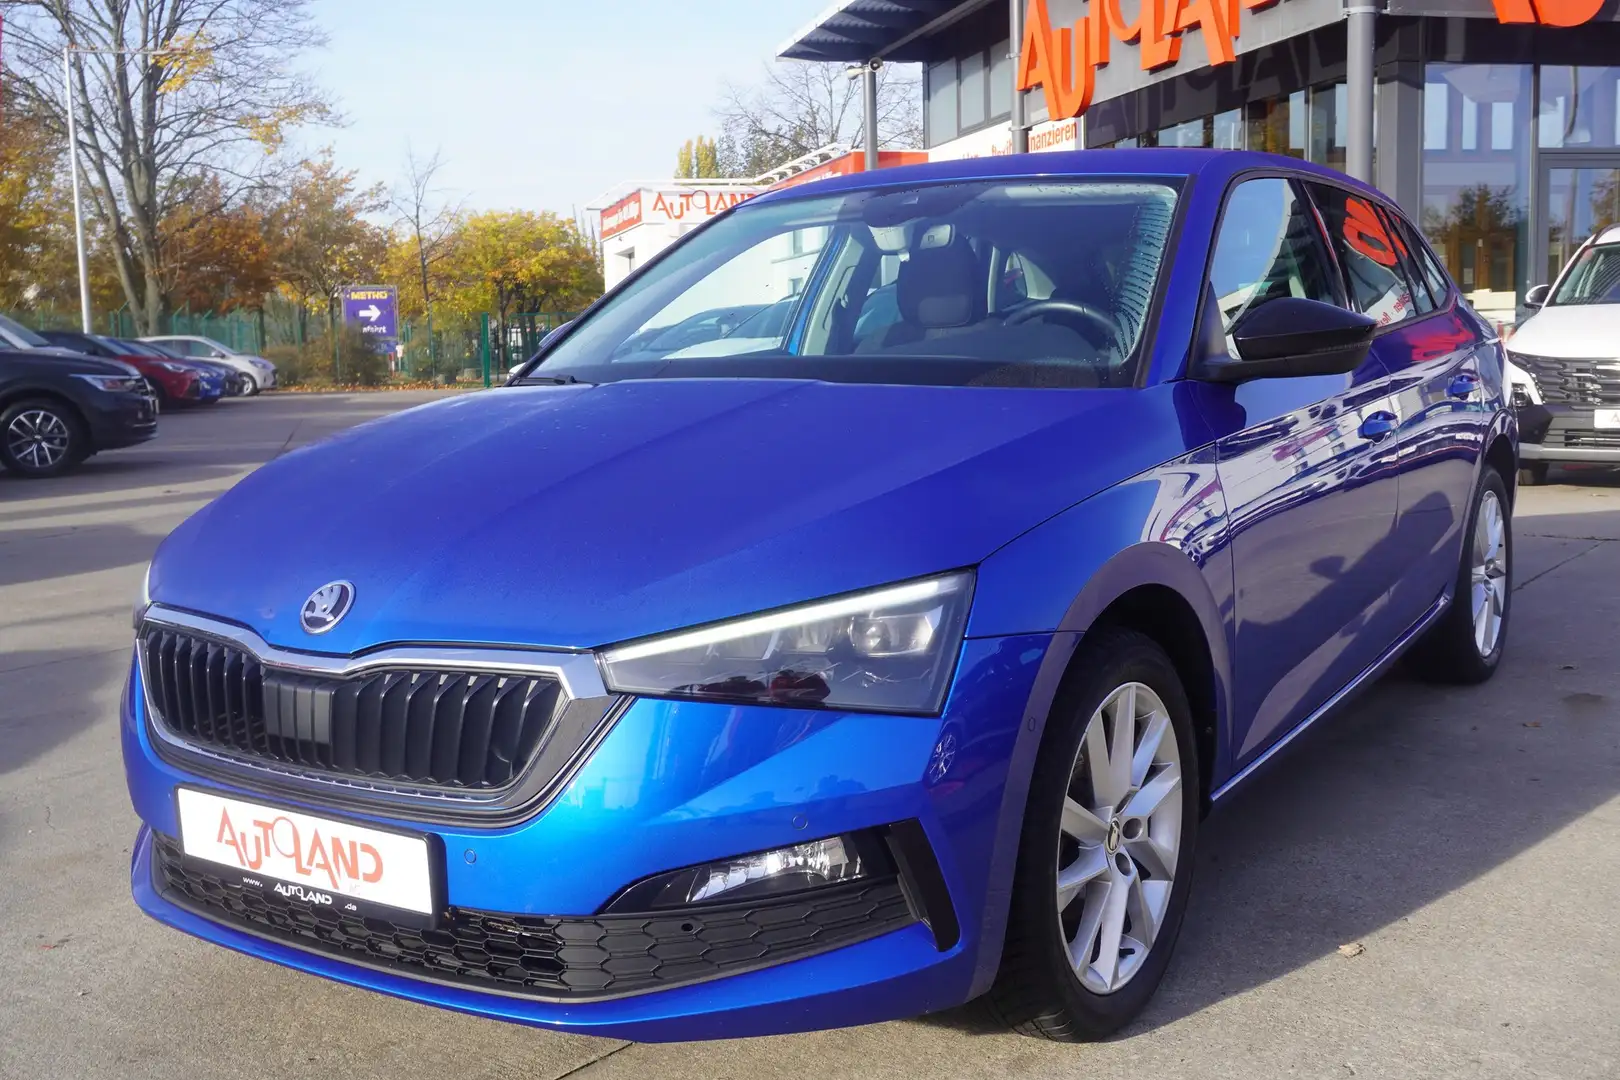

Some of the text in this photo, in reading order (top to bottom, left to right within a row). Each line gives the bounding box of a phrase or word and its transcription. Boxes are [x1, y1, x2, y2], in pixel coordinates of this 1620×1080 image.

[1028, 121, 1077, 152] nanzieren
[652, 189, 757, 220] AUTOLAN
[351, 291, 388, 300] METRO
[216, 806, 384, 890] AUTOLAND
[273, 882, 333, 905] AUTOLAND
